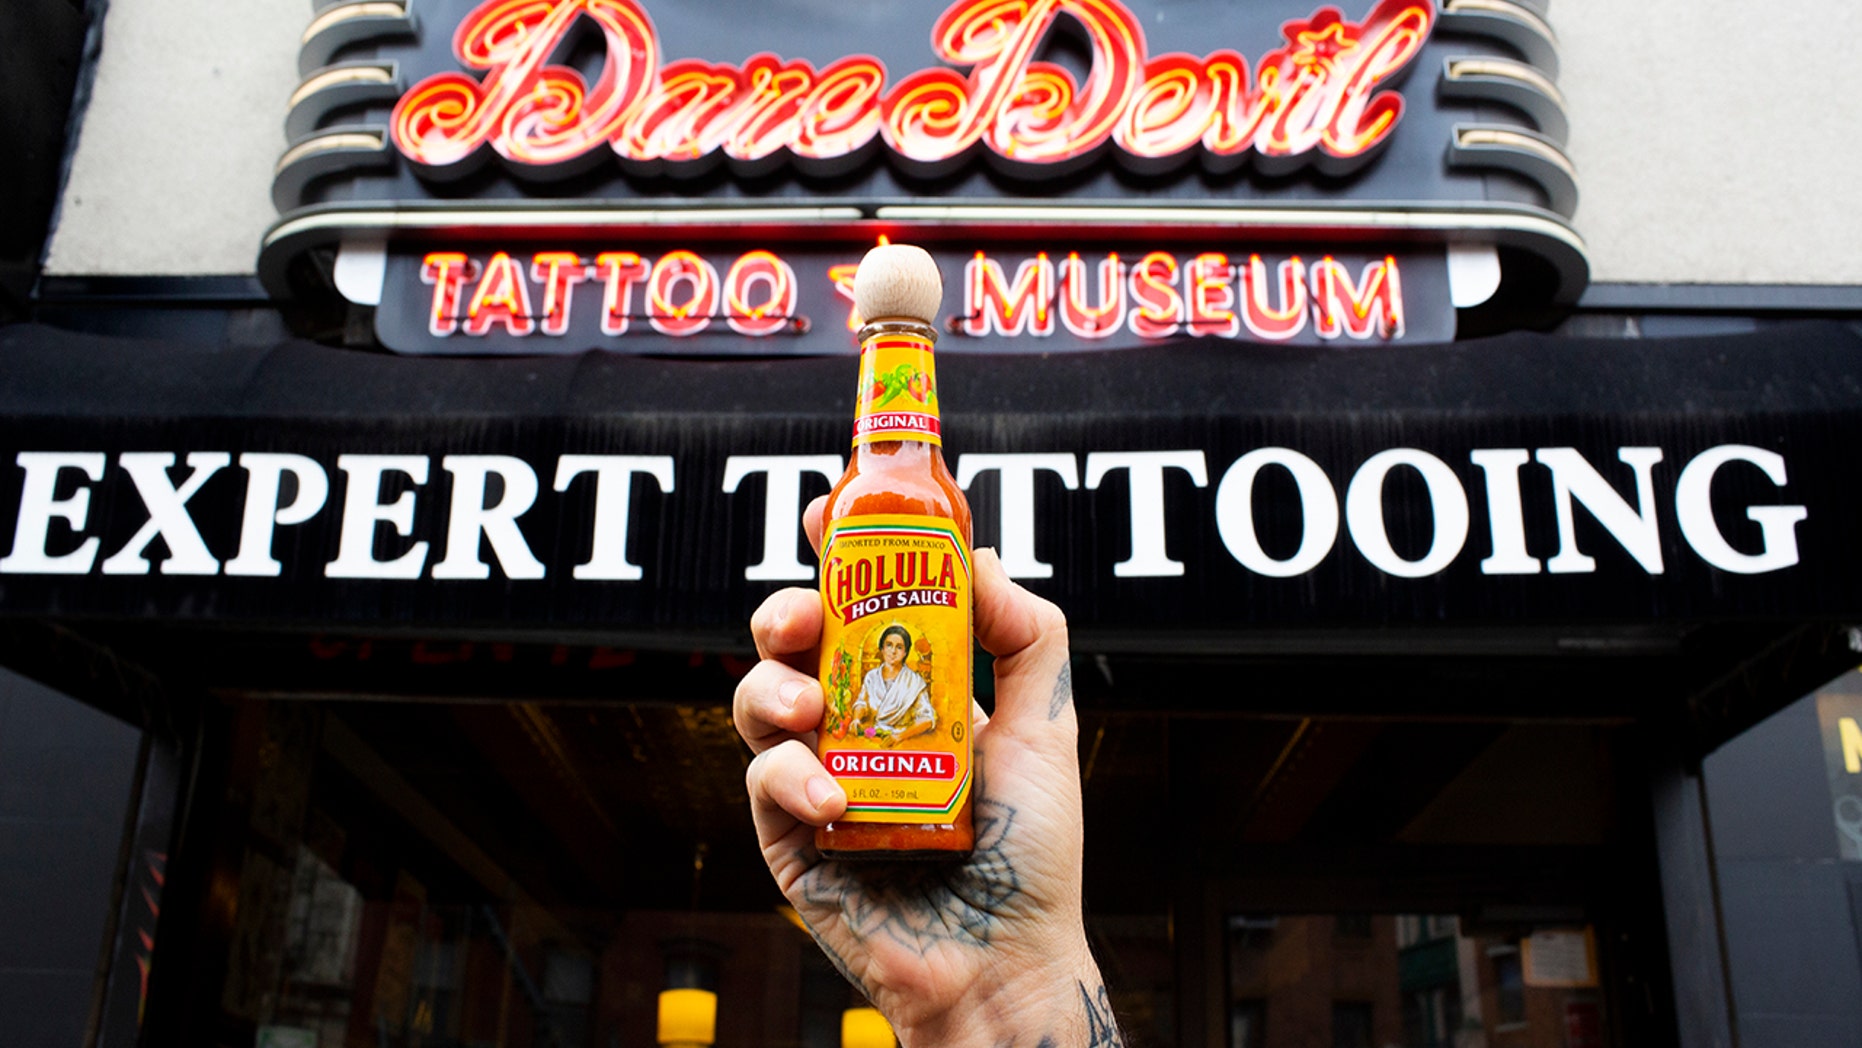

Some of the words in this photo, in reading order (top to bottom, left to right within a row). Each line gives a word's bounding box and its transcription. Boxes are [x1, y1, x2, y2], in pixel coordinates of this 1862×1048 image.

[390, 0, 888, 165] Dare
[880, 0, 1436, 163] Devil
[420, 250, 799, 336] TATTOO
[964, 251, 1406, 340] MUSEUM
[857, 415, 927, 432] ORIGINAL
[0, 451, 675, 580] EXPERT
[722, 444, 1808, 581] TTTOOING
[840, 539, 881, 549] IMPORTED
[883, 538, 910, 548] FROM
[912, 540, 946, 550] MEXICO
[825, 551, 957, 619] CHOLULA
[851, 594, 892, 619] HOT
[896, 590, 949, 607] SAUCE
[831, 755, 946, 774] ORIGINAL
[890, 789, 905, 799] 150
